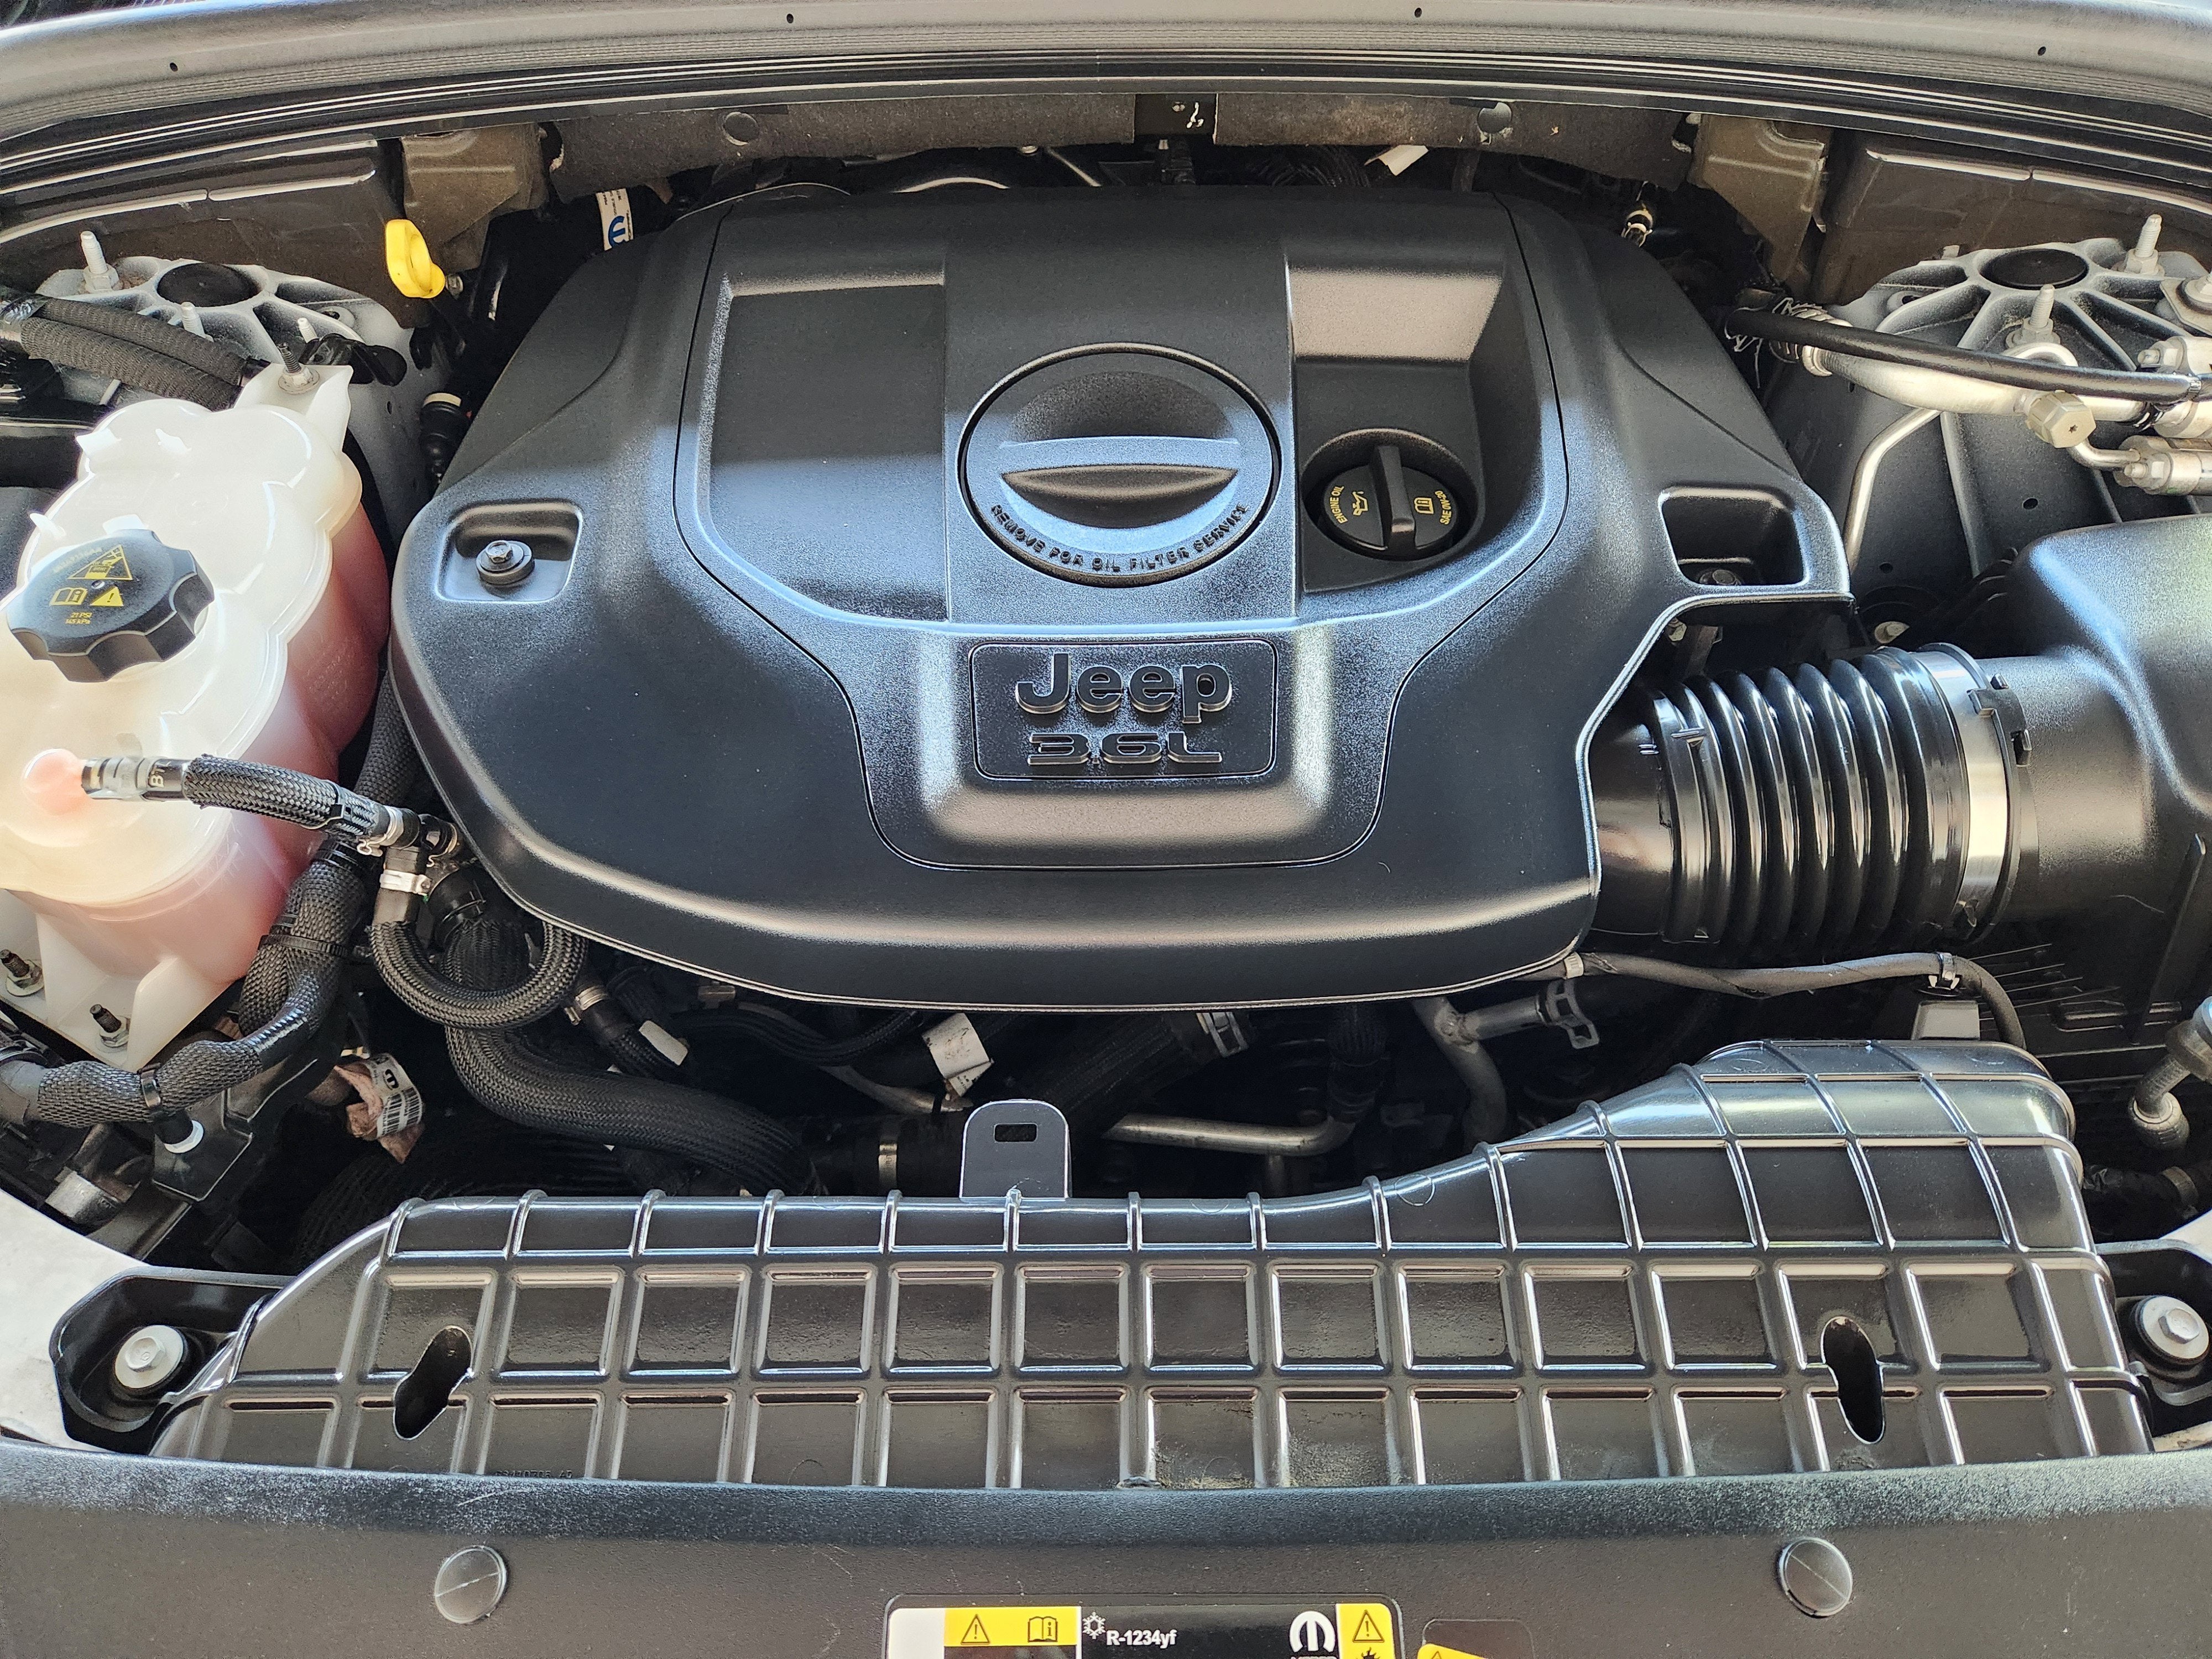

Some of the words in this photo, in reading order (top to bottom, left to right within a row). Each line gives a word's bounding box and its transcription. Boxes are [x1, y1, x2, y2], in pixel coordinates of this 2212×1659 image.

[1331, 486, 1344, 496] OIL
[1434, 490, 1451, 510] 0W-20
[1329, 497, 1348, 524] ENGINE
[1439, 510, 1452, 525] SAE
[991, 504, 1046, 552] REMOVE
[1049, 547, 1084, 567] FOR
[1092, 557, 1121, 572] OIL
[1130, 546, 1190, 571] FILTER
[1193, 501, 1249, 552] SERVICE
[1015, 652, 1233, 724] Jeep
[1027, 732, 1223, 765] 3.6L
[1106, 1629, 1178, 1650] R-1234yf
